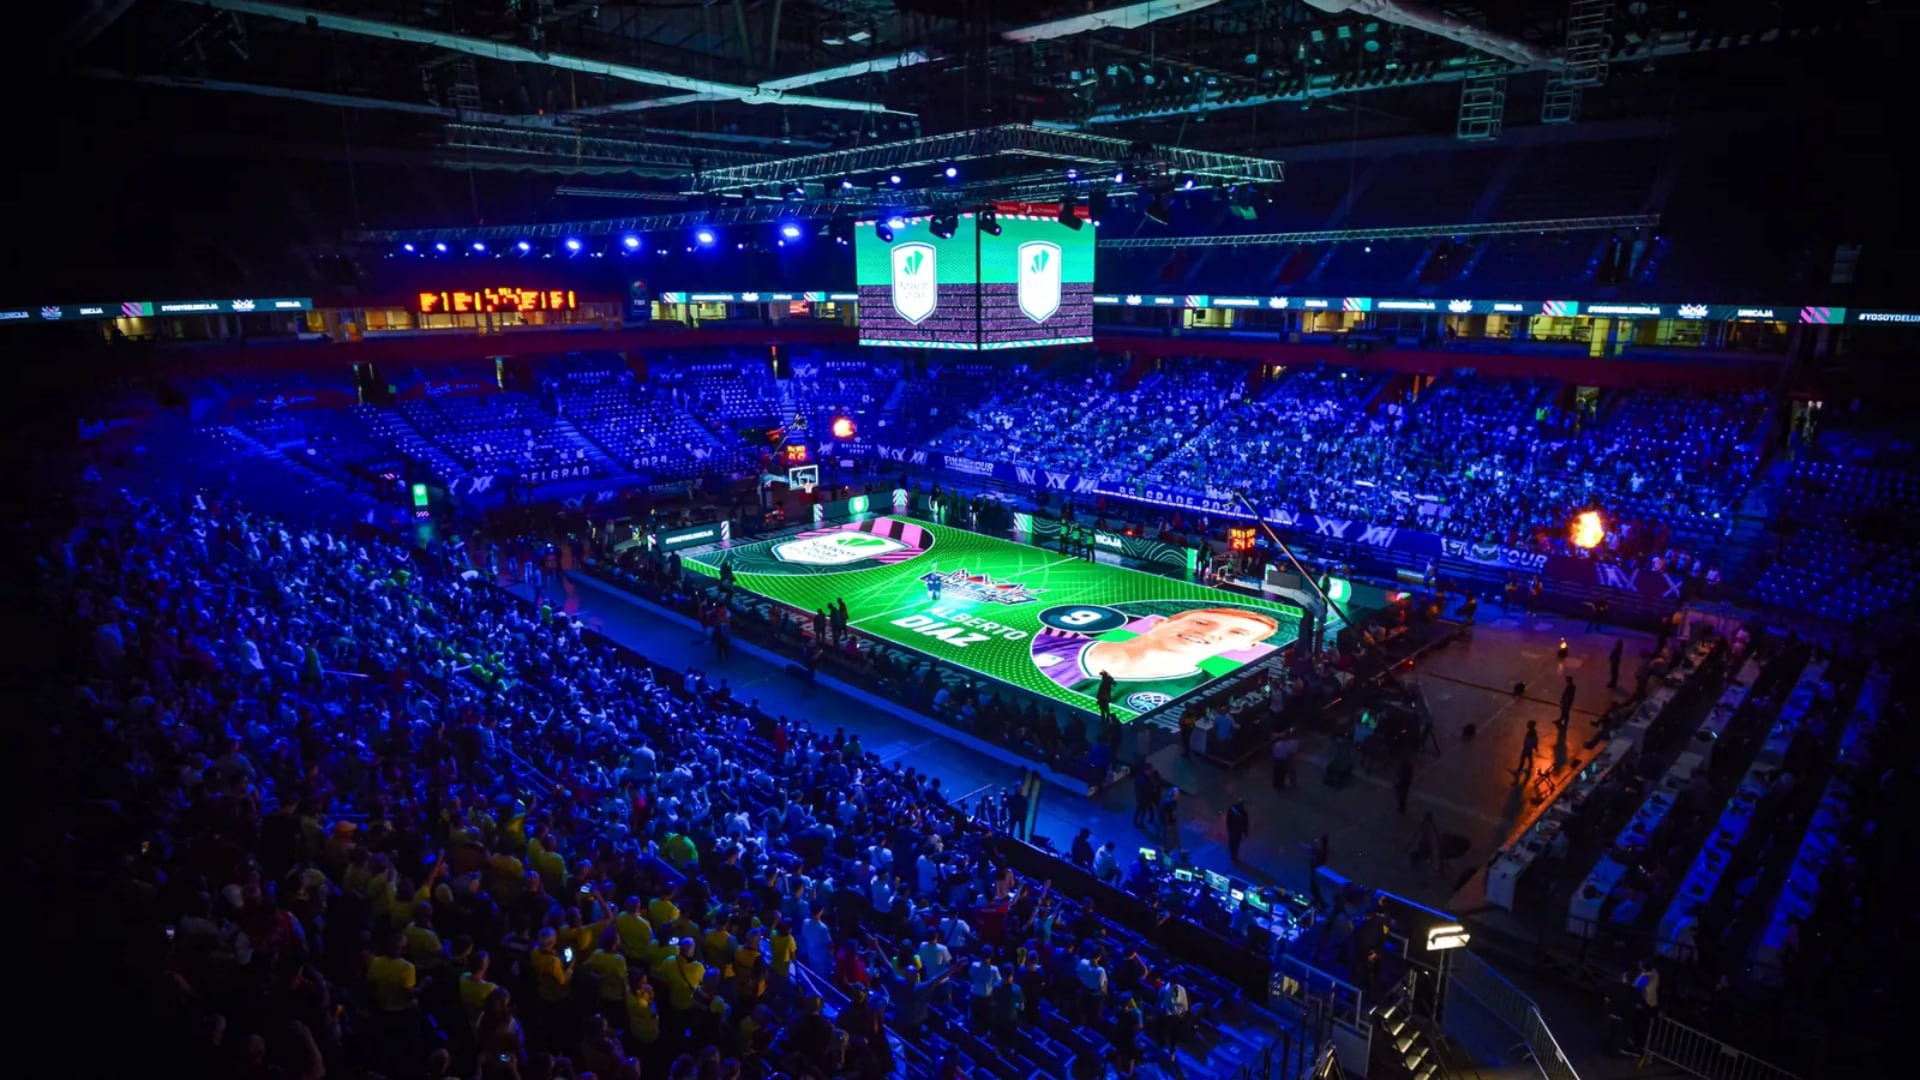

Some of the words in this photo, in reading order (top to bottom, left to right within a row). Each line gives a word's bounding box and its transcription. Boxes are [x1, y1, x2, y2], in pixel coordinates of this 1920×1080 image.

[1738, 309, 1773, 318] UNICAJA
[928, 607, 1029, 641] ALBERTO
[1059, 609, 1103, 626] 9
[890, 614, 993, 648] DIAZ
